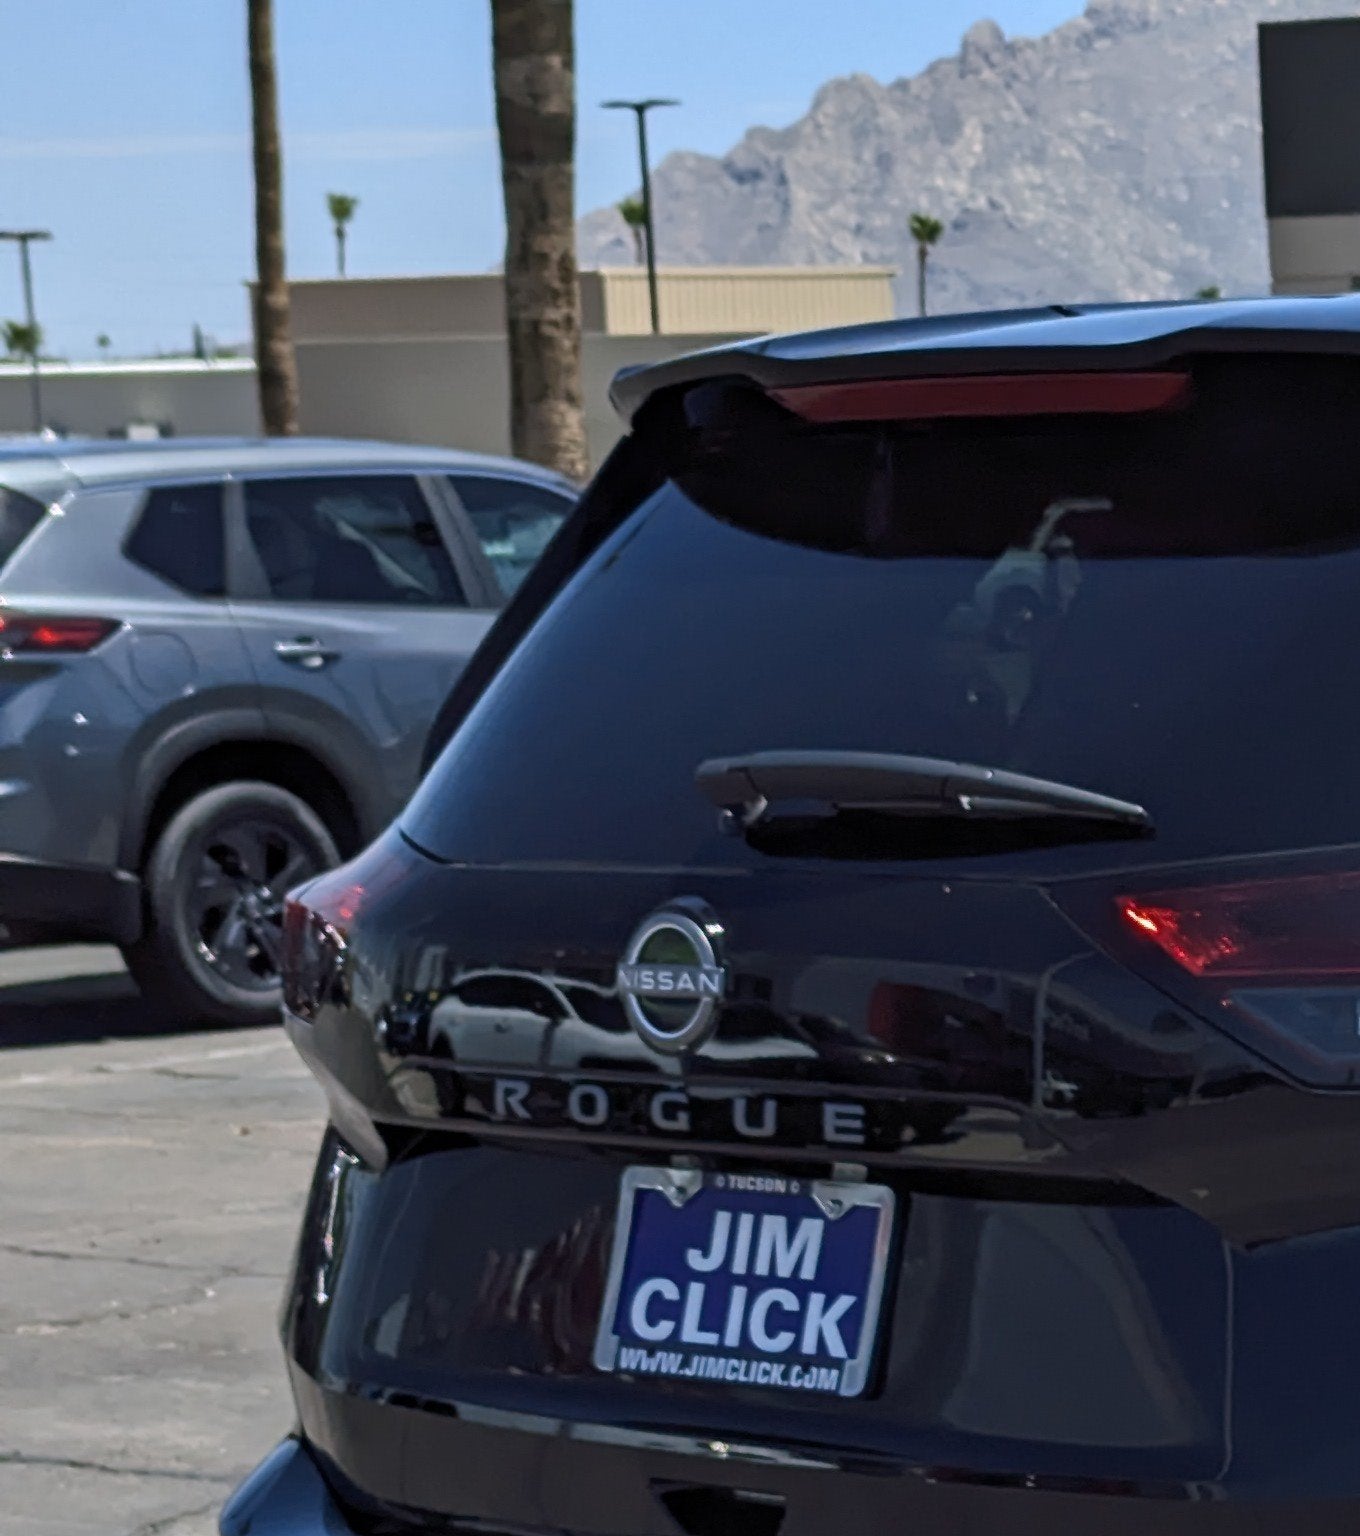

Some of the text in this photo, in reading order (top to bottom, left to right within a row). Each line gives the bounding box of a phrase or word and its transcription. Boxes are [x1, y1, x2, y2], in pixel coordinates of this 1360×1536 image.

[618, 968, 723, 993] NISSAN
[494, 1079, 865, 1143] ROGUE
[727, 1173, 788, 1194] TUCSON
[686, 1210, 825, 1281] JIM
[629, 1277, 858, 1359] CLICK
[619, 1346, 840, 1392] WWW.JIMCLICK.COM
